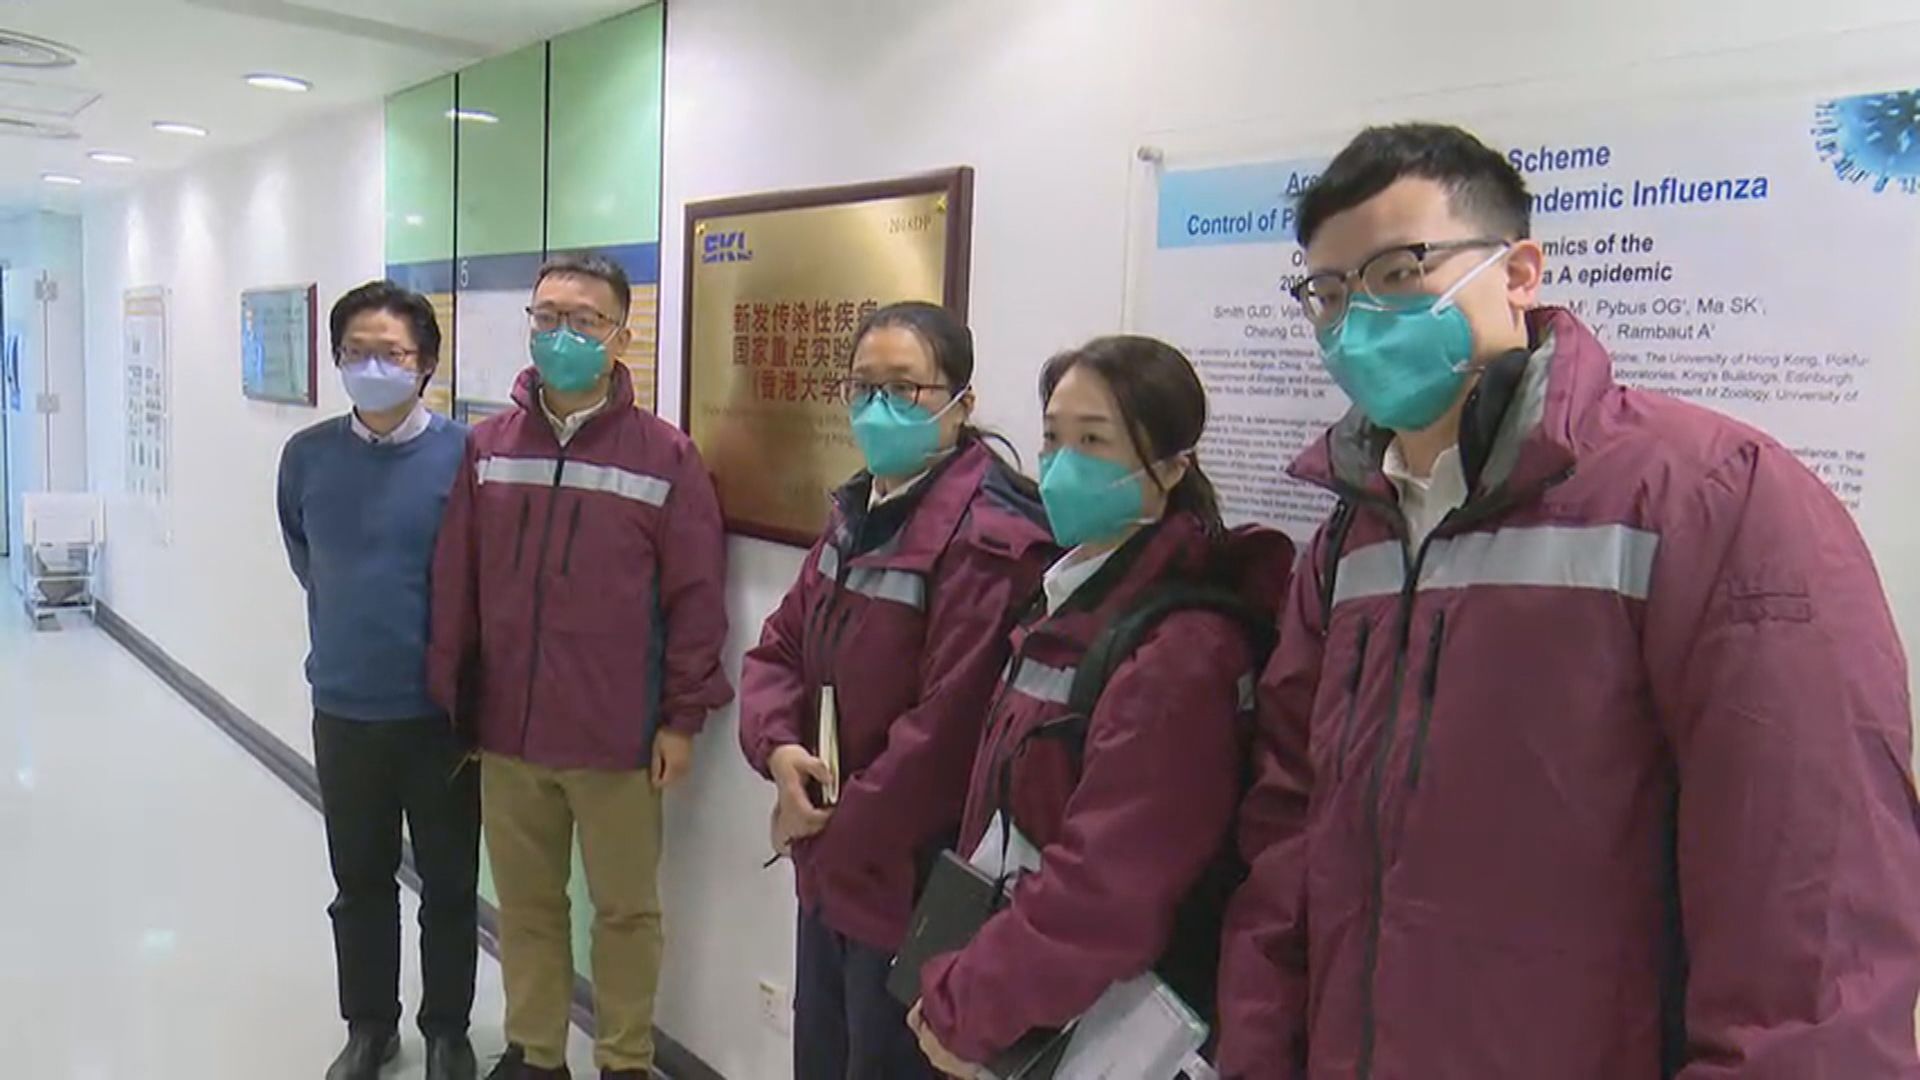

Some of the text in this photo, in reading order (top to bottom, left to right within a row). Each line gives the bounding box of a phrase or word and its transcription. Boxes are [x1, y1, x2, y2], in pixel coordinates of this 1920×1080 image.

[1508, 144, 1612, 173] Scheme
[1187, 175, 1769, 236] Control of P ndemic Influenza
[1542, 238, 1588, 257] mics
[1593, 233, 1618, 255] of
[1620, 233, 1655, 254] the
[1542, 269, 1553, 286] a
[1557, 266, 1573, 286] A
[1577, 261, 1674, 288] epidemic
[1596, 299, 1648, 319] Pybus
[1696, 297, 1724, 315] Ma
[1617, 322, 1694, 340] Rambaut
[733, 335, 852, 369] 国家重点实验
[1671, 353, 1727, 367] University
[1746, 354, 1781, 367] Hong
[1785, 371, 1854, 385] Edinburgh
[1775, 388, 1840, 403] University
